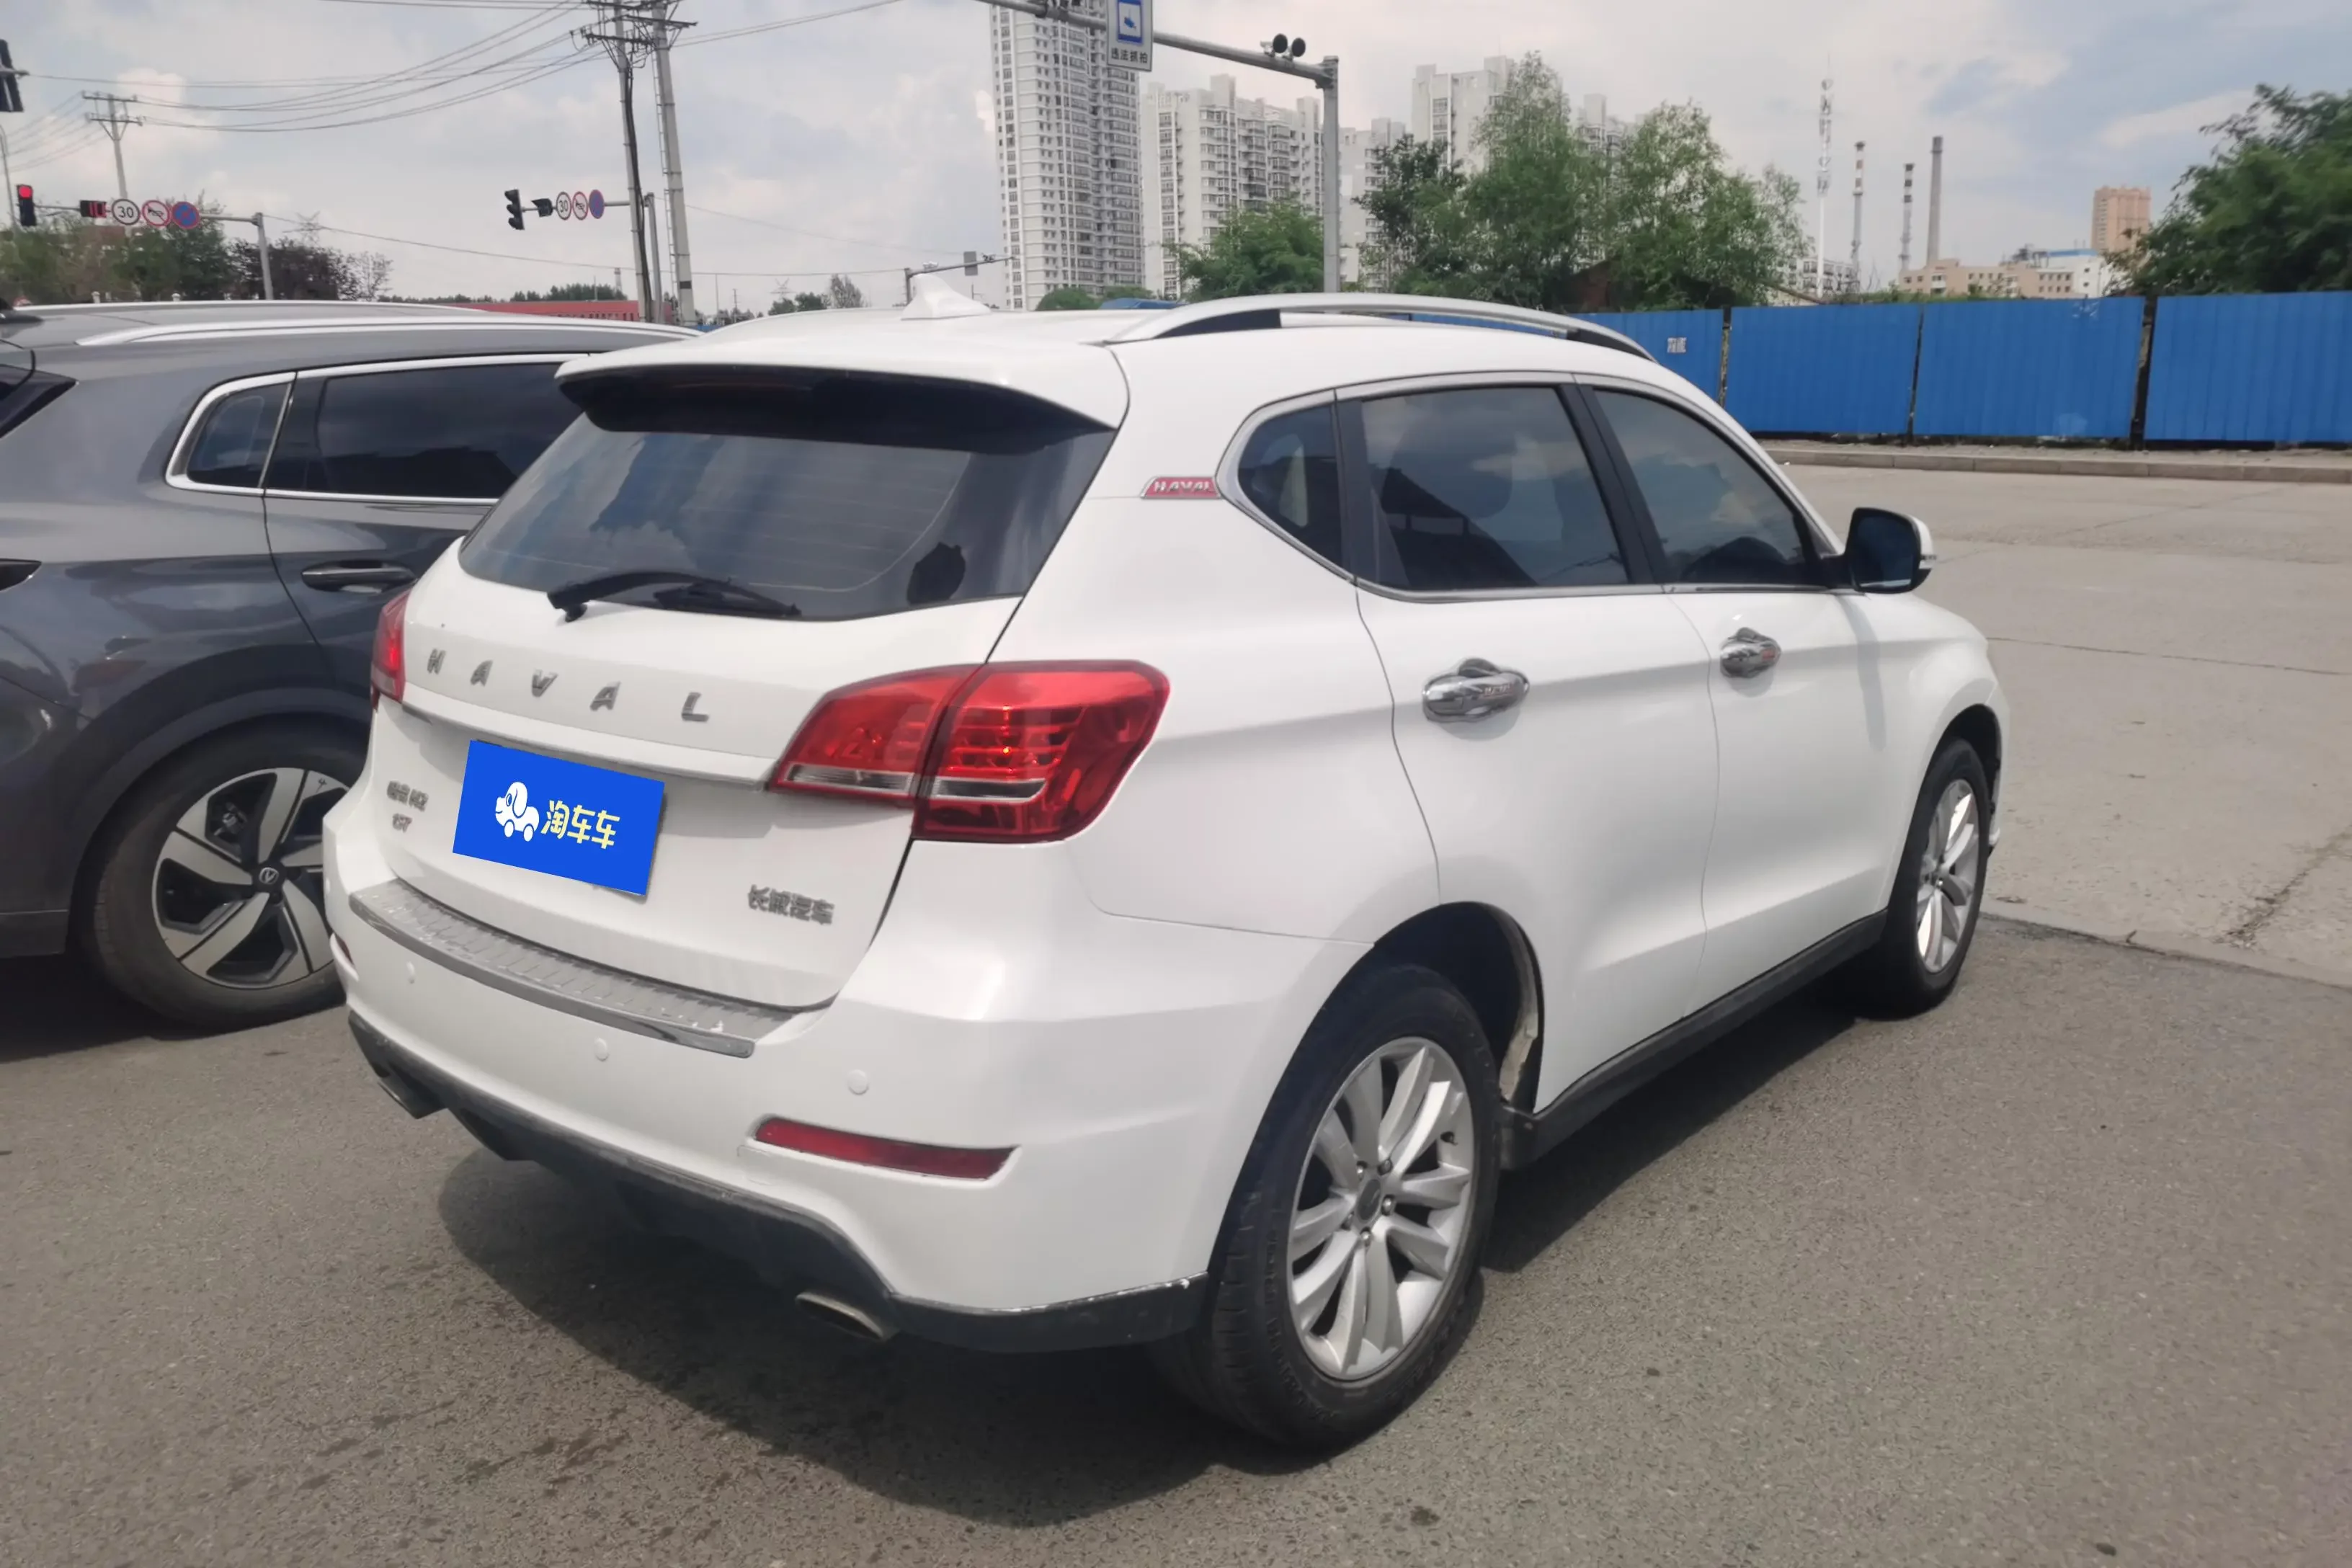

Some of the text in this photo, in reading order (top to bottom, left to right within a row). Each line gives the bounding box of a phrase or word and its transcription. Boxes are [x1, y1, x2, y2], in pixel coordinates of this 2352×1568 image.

[118, 206, 135, 218] 30
[559, 200, 569, 213] 30
[1153, 481, 1215, 493] HAVAL
[427, 649, 710, 722] HAVAL
